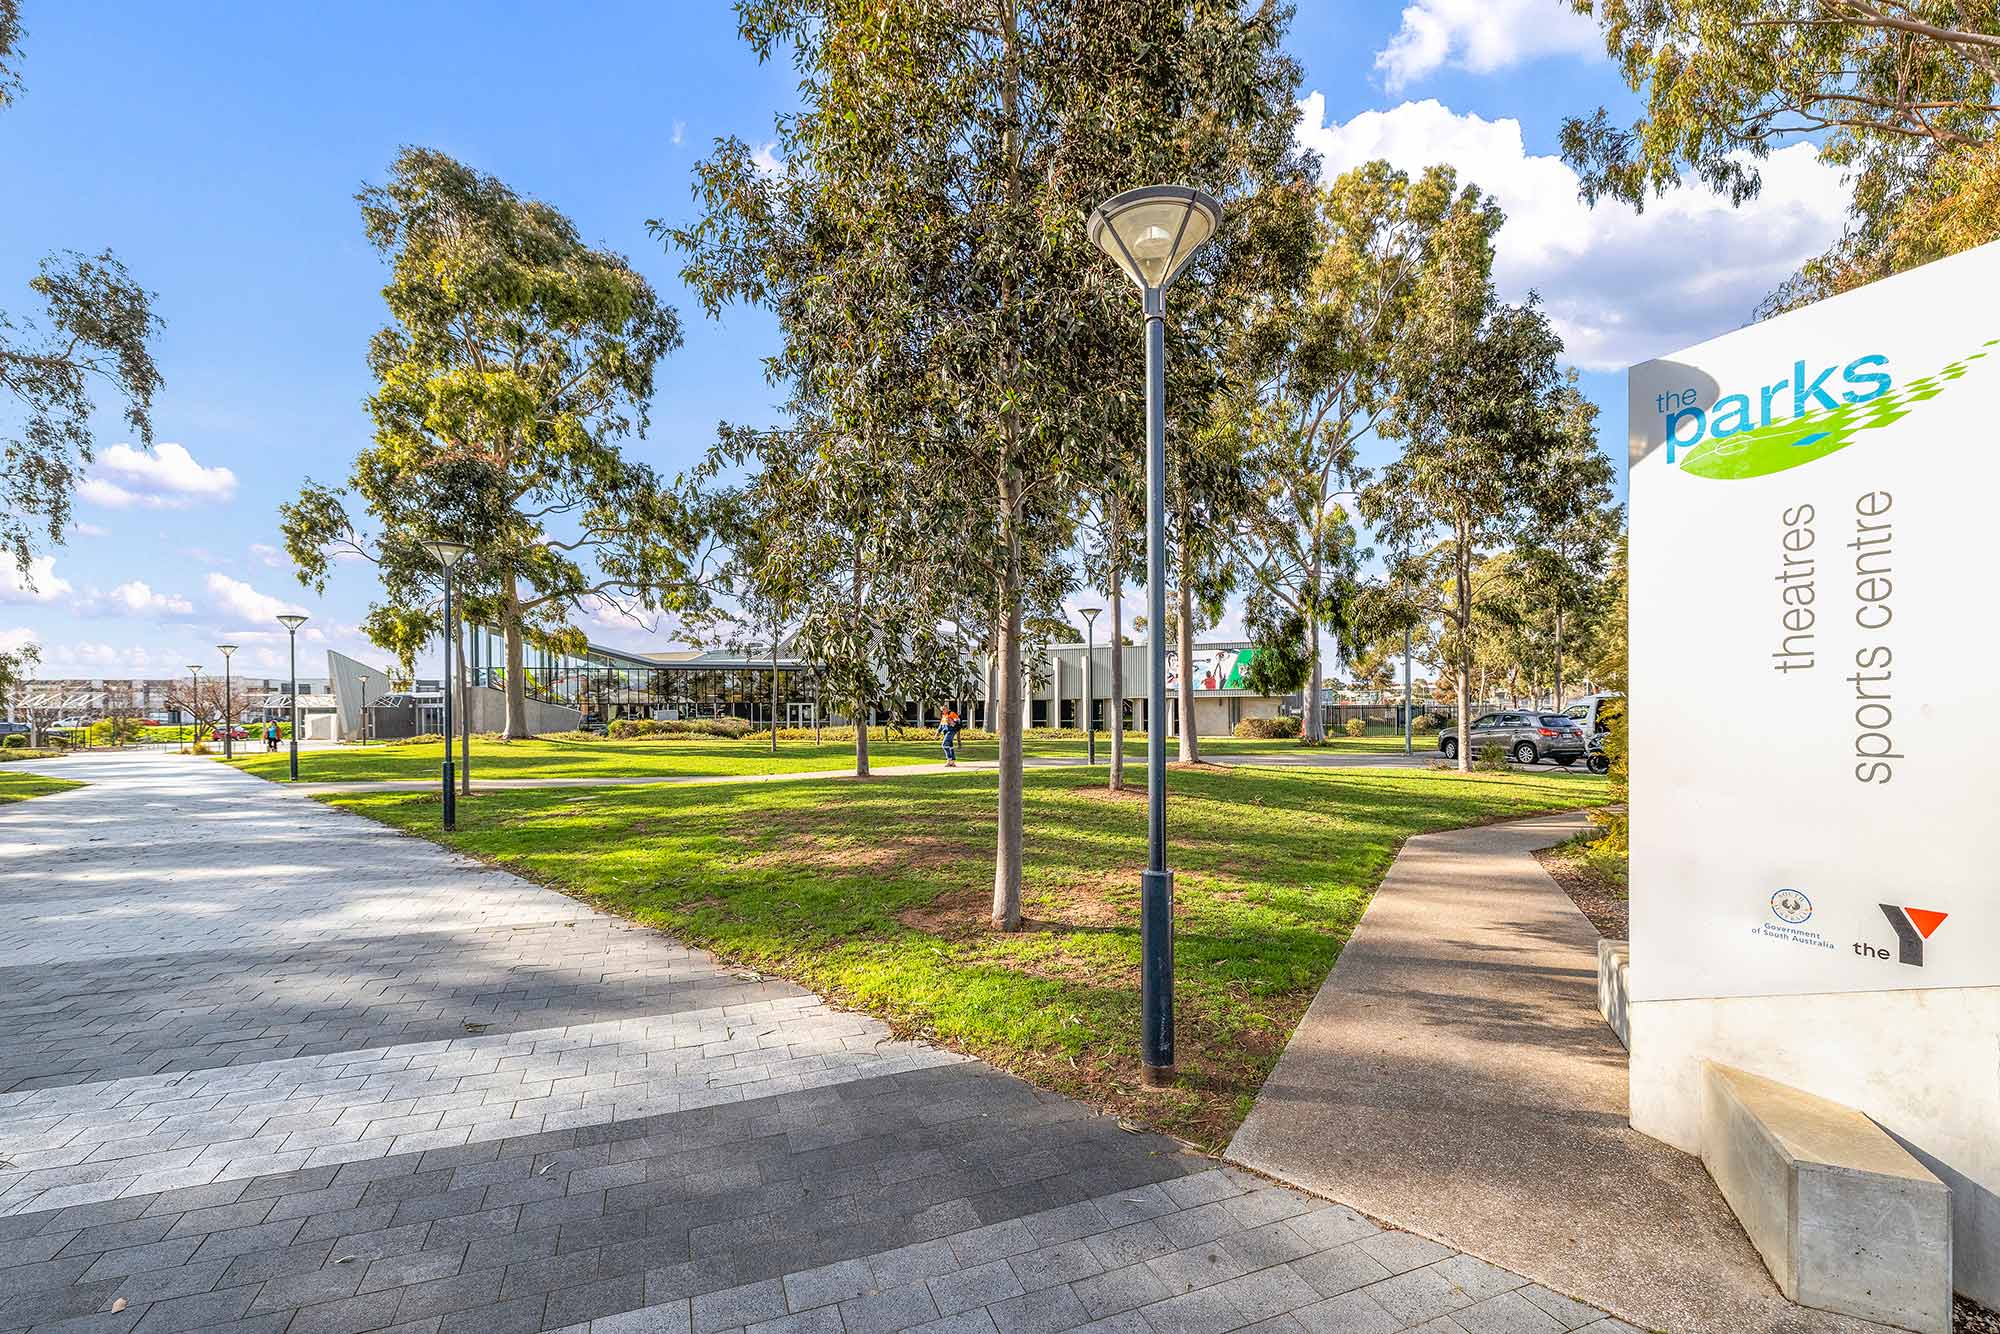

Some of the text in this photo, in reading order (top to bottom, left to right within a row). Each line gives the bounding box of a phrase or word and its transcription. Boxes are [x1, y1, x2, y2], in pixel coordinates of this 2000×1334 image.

[1655, 388, 1697, 414] the
[1665, 354, 1892, 464] parks
[1772, 503, 1815, 673] theatres
[1846, 490, 1905, 785] sports centre
[1751, 927, 1835, 950] of South Australia
[1764, 922, 1821, 940] Government
[1852, 903, 1949, 968] the Y
